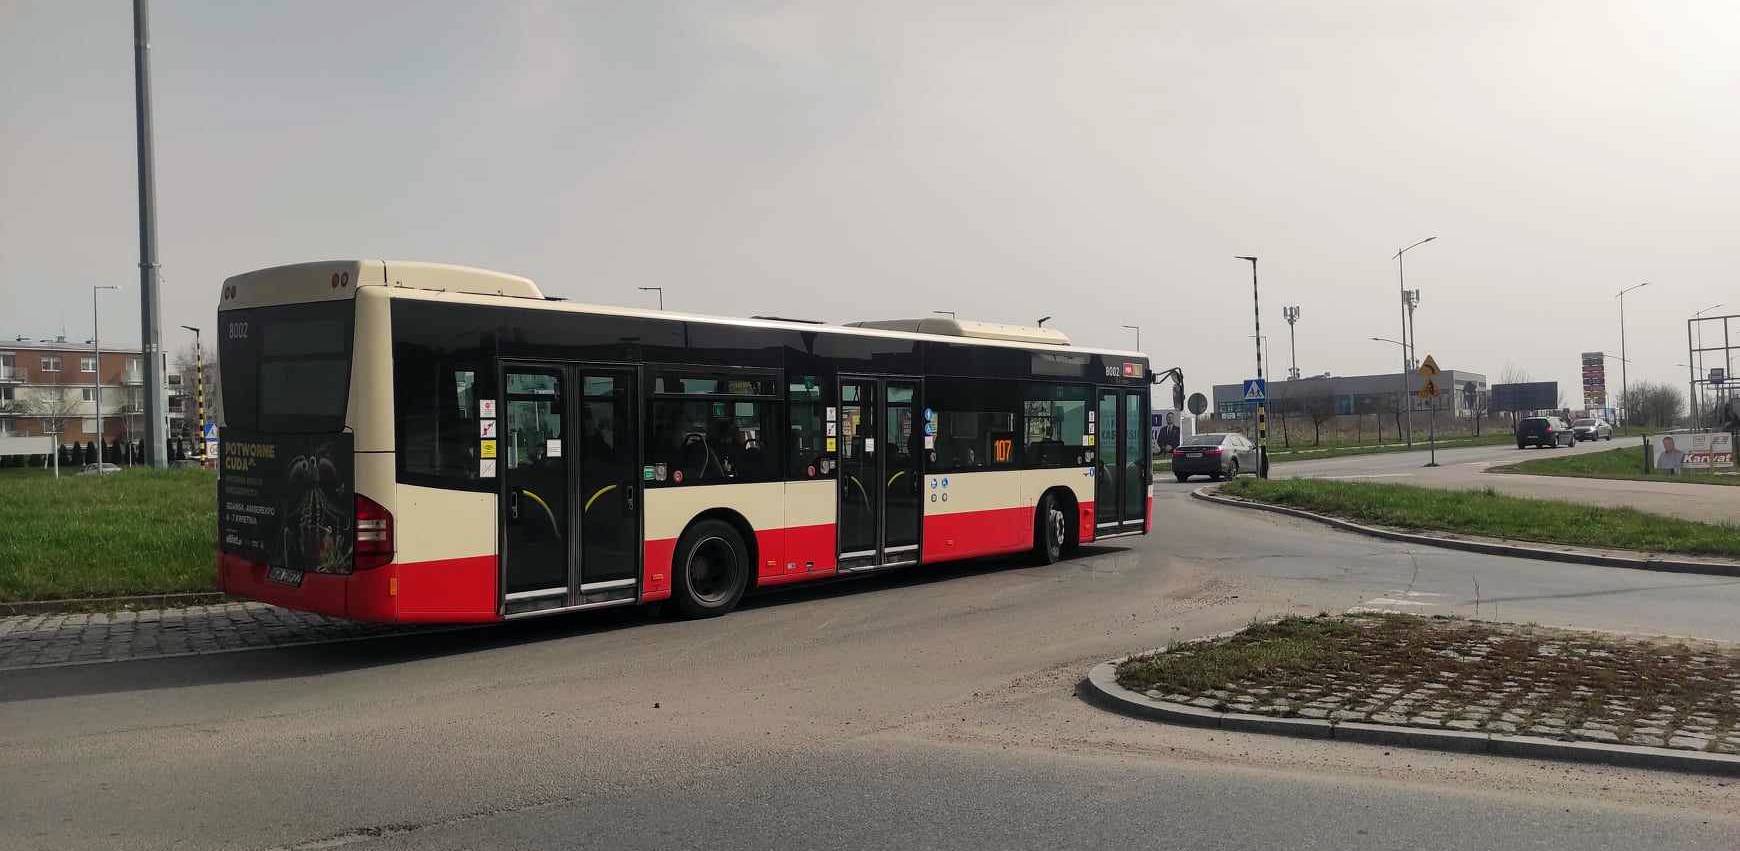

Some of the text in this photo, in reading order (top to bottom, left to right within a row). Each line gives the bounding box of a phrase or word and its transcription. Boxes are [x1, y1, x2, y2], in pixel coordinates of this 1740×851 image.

[229, 322, 248, 339] 8002
[1105, 366, 1120, 376] 8002
[225, 442, 275, 459] POTWORNE
[994, 439, 1012, 462] 107
[225, 457, 249, 471] CUDA
